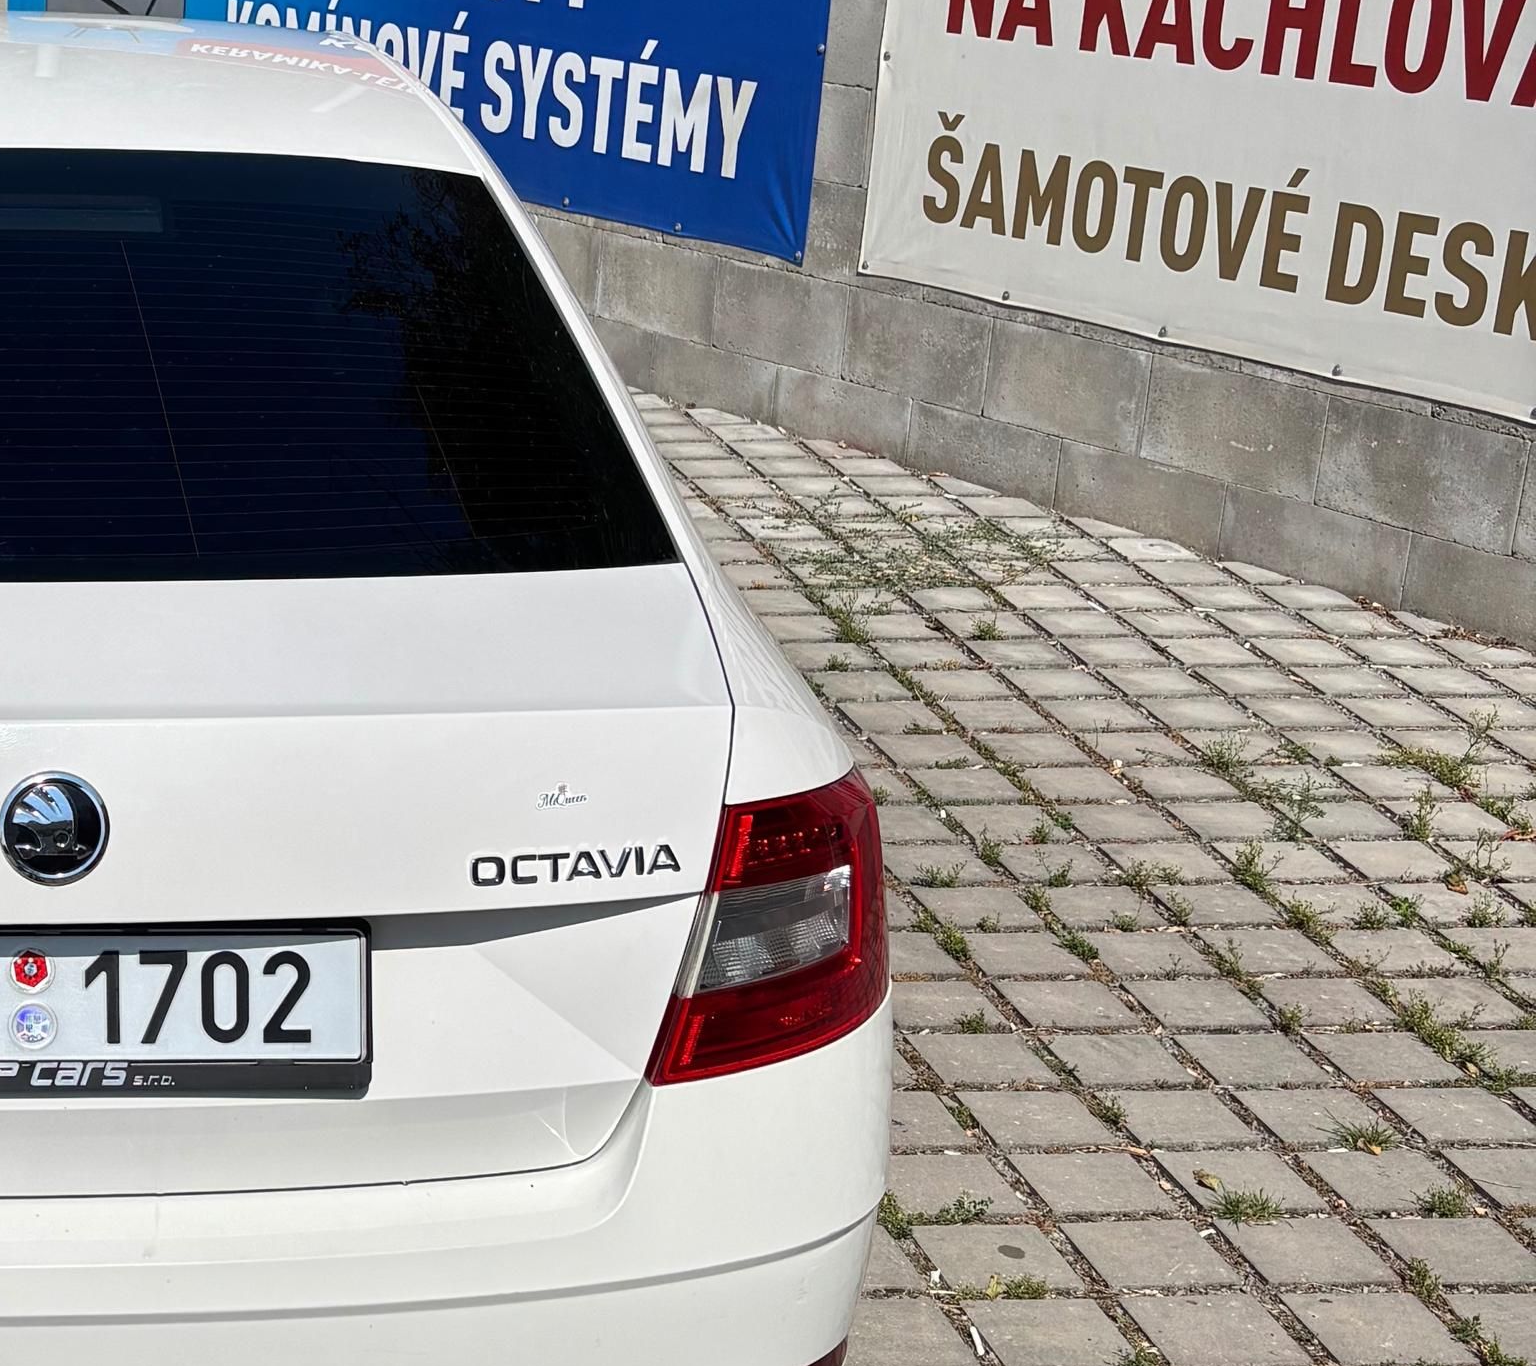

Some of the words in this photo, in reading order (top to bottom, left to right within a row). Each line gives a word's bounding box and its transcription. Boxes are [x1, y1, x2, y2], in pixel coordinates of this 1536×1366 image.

[480, 39, 758, 179] SYSTÉMY
[922, 110, 1311, 294] ŠAMOTOVÉ
[470, 844, 681, 887] OCTAVIA
[84, 949, 312, 1045] 1702
[132, 1075, 176, 1086] s.r.o.
